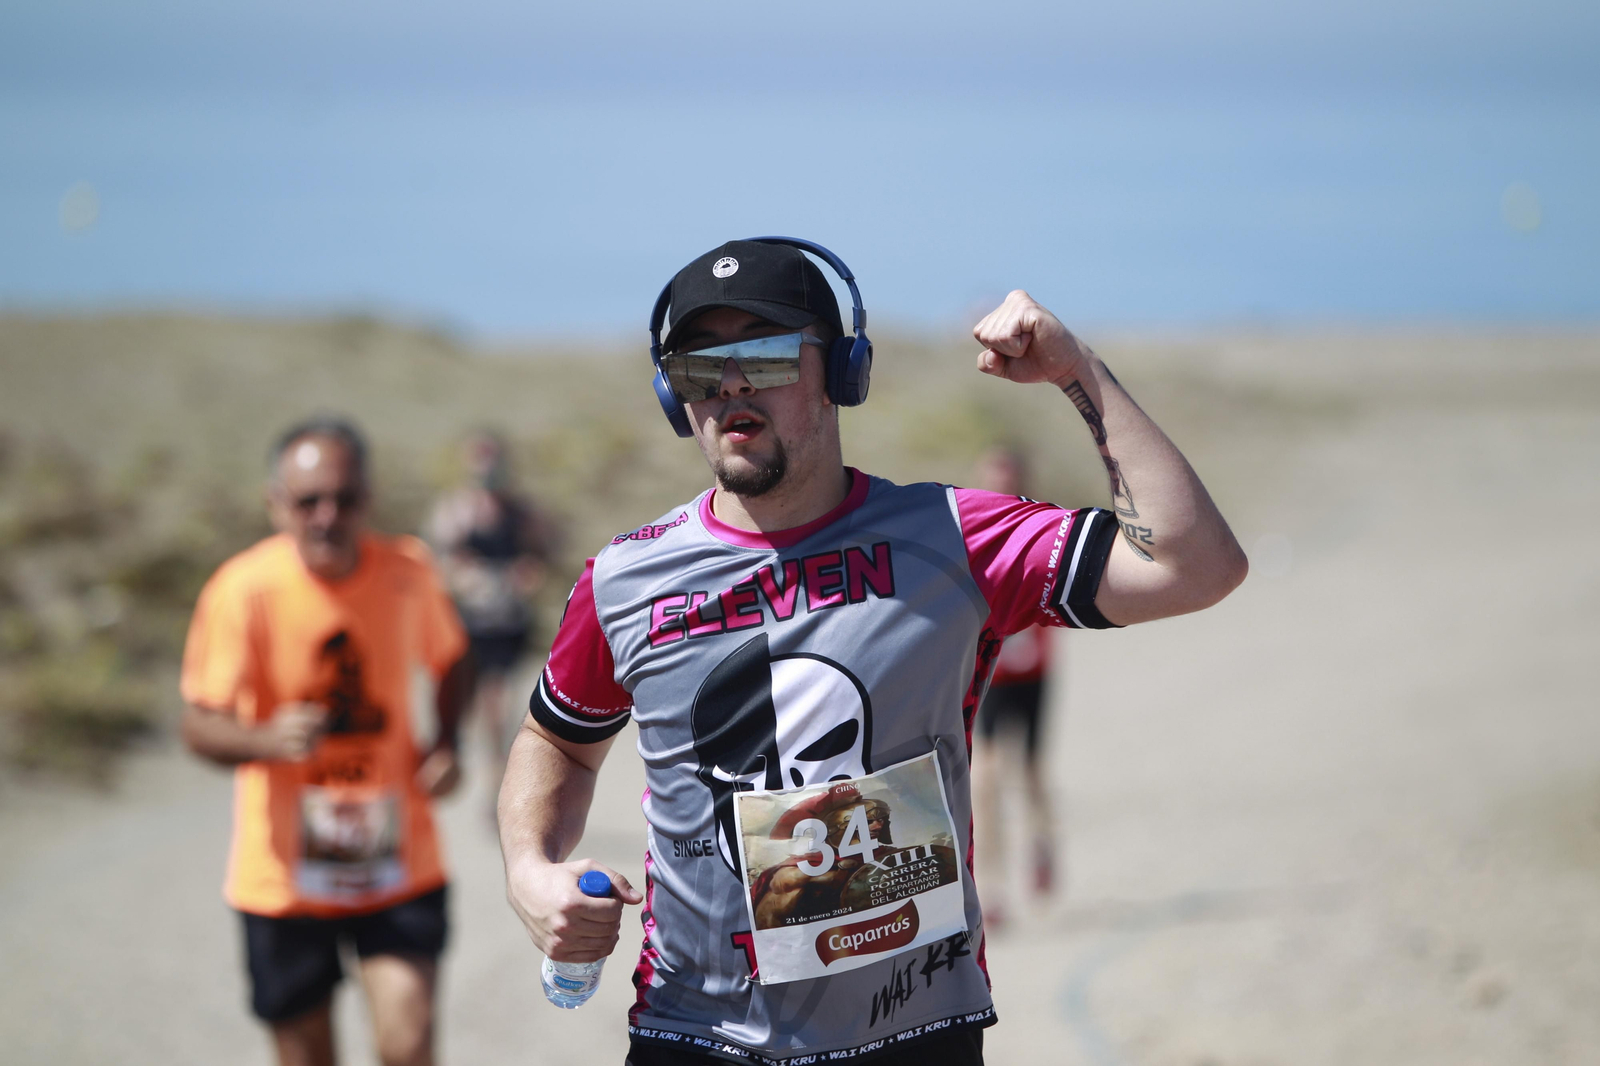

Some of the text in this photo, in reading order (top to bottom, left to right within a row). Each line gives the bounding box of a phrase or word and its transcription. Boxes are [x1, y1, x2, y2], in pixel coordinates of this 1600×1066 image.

[1047, 512, 1073, 569] WAI KRU
[647, 541, 896, 650] ELEVEN
[556, 690, 581, 709] WAI
[581, 705, 611, 715] KRU
[835, 783, 860, 794] CHINO
[673, 839, 714, 858] SINCE
[792, 804, 879, 878] 34
[867, 843, 936, 876] XIII
[868, 859, 939, 883] CARRERA
[870, 866, 939, 892] POPULAR
[871, 878, 940, 906] DEL ALQUIÁN
[886, 872, 940, 894] ESPARTANOS
[809, 912, 831, 920] enero
[832, 905, 853, 916] 2024
[869, 957, 918, 1029] WAI
[639, 1028, 658, 1038] WAI
[658, 1031, 682, 1041] KRU
[693, 1037, 723, 1050] WAI
[722, 1044, 750, 1057] KRU
[790, 1054, 817, 1066] KRU
[829, 1049, 858, 1060] WAI
[859, 1039, 884, 1055] KRU
[896, 1028, 922, 1042] WAI
[924, 1018, 951, 1034] KRU
[965, 1007, 992, 1023] WAI
